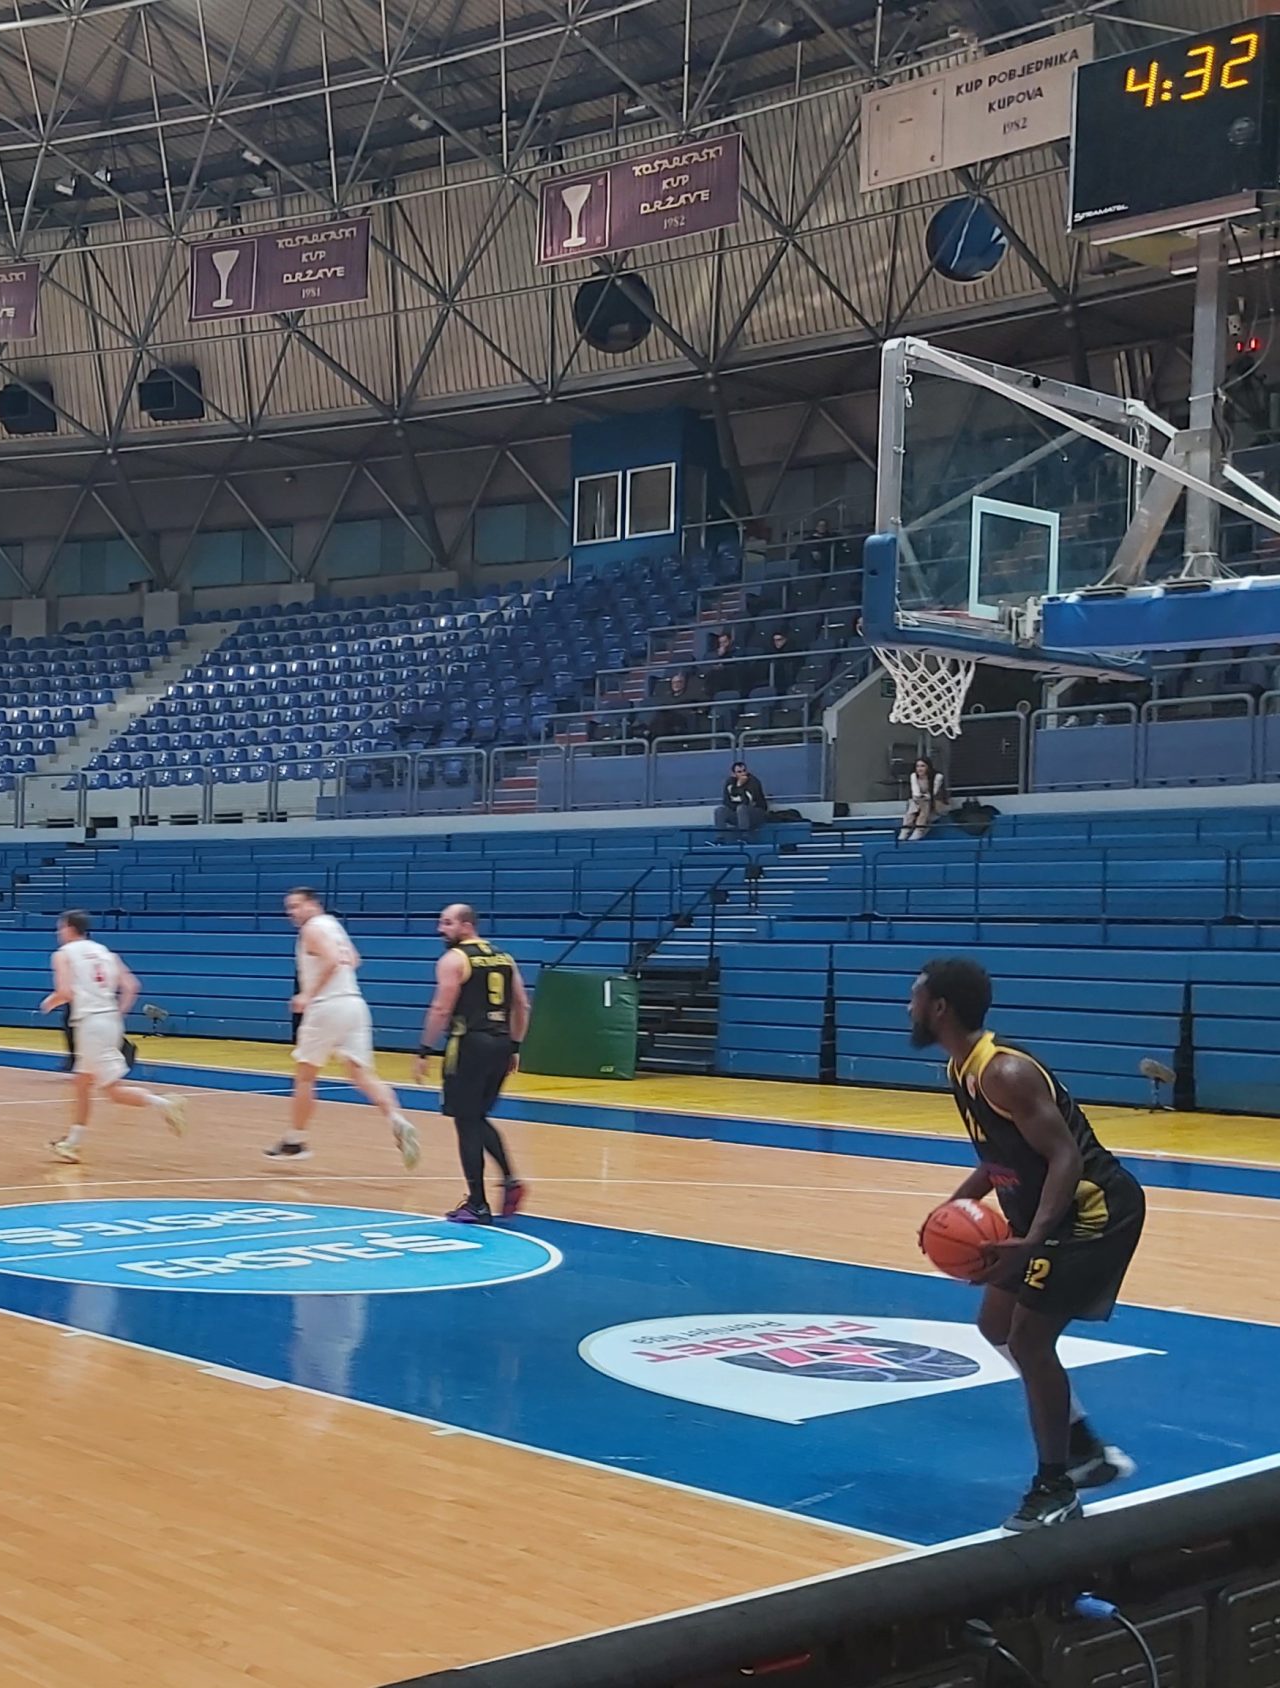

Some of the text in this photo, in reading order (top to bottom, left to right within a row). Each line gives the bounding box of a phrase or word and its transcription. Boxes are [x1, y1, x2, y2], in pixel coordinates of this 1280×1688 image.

[956, 49, 1079, 96] KUP POBJEDNIKA
[1125, 32, 1259, 107] 4:32
[988, 86, 1044, 113] KUPOVA
[662, 175, 689, 190] KUP
[663, 216, 685, 230] 1982
[302, 251, 326, 263] KUP
[487, 971, 505, 1005] 9
[58, 1208, 317, 1236] ERSTE
[116, 1242, 405, 1279] ERSTE
[630, 1321, 879, 1363] FAVBET
